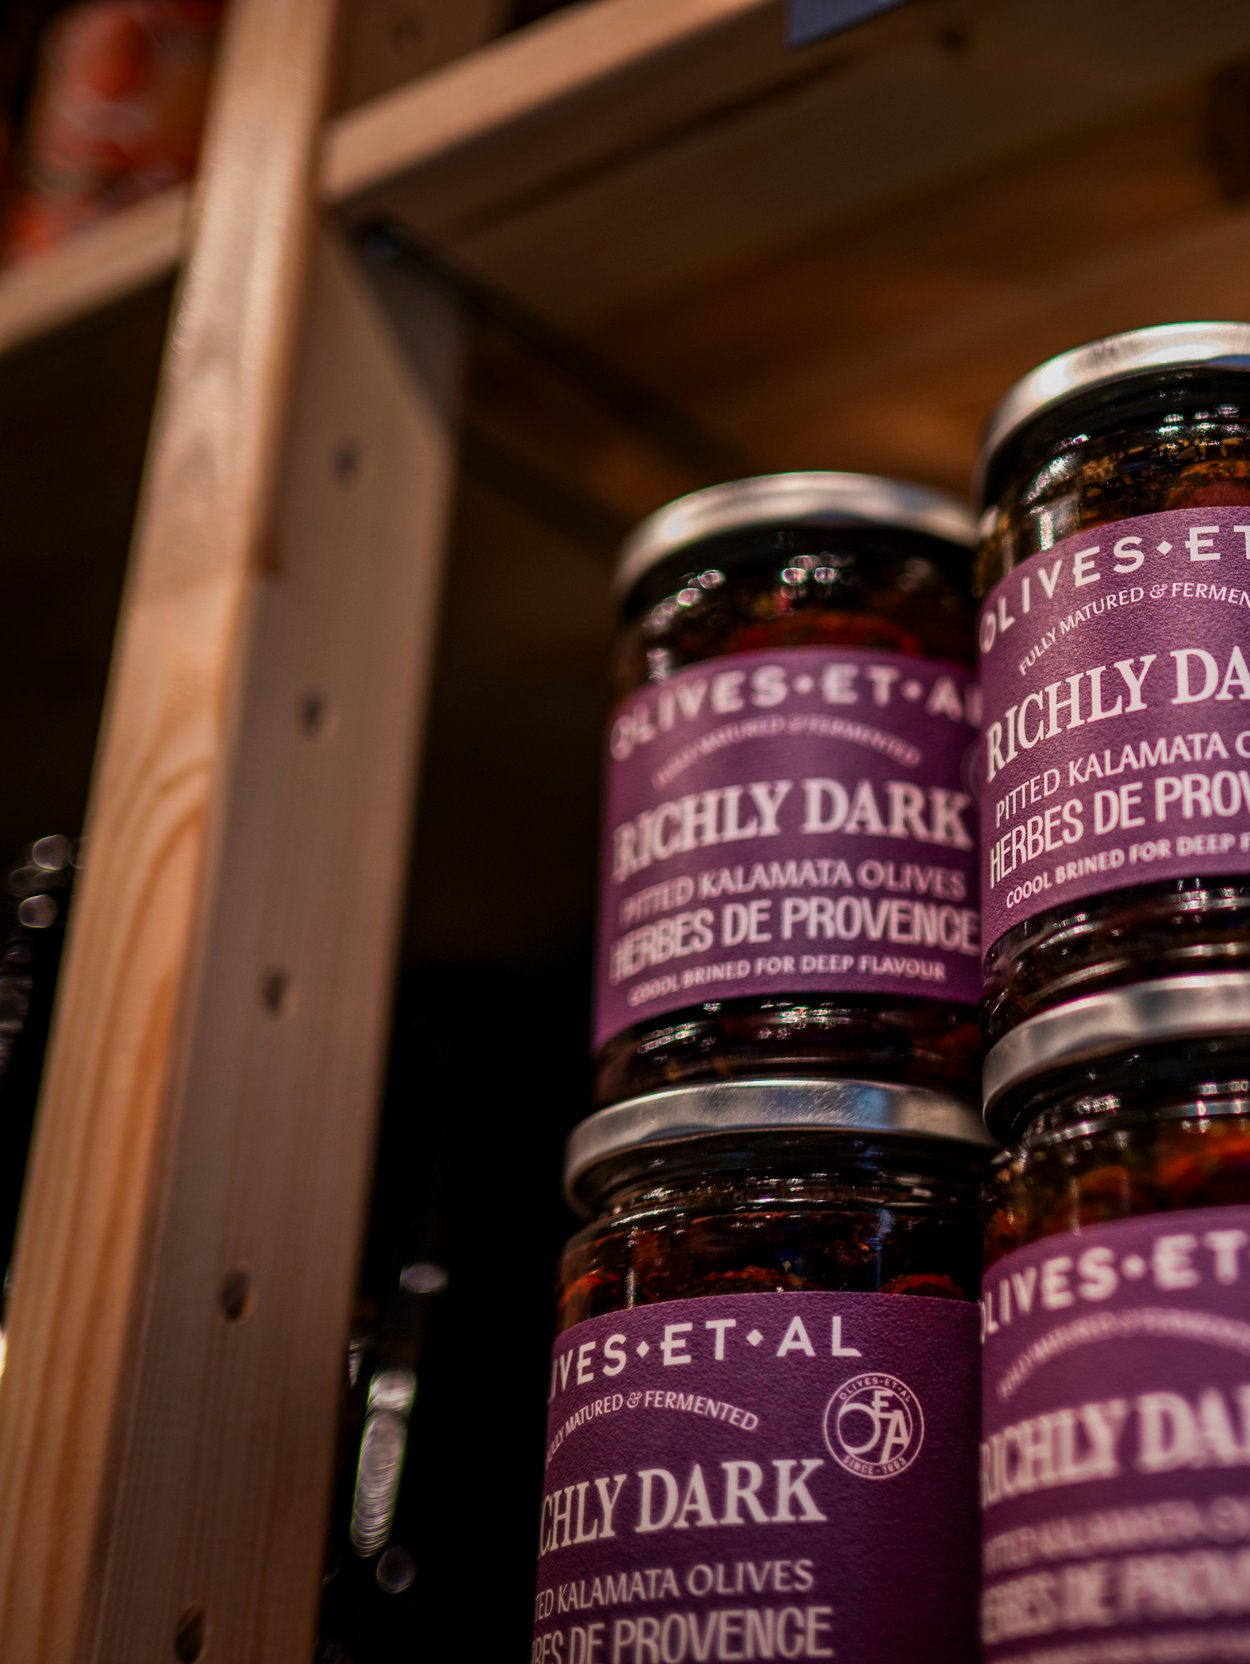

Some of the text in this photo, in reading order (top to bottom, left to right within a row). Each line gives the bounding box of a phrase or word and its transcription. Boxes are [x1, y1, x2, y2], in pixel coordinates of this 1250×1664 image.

[979, 536, 1145, 653] OLIVES
[1019, 628, 1057, 676] FULLY
[1059, 587, 1144, 635] MATURED
[1150, 583, 1168, 598] &
[610, 666, 788, 761] OLIVES
[822, 664, 899, 705] ET
[986, 654, 1156, 784] RICHLY
[995, 768, 1060, 829] PITTED
[1068, 731, 1229, 787] KALAMATA
[610, 777, 974, 886] RICHLY DARK
[990, 799, 1084, 889] HERBES
[1093, 781, 1145, 836] DE
[1006, 872, 1052, 909] COOOL
[1055, 849, 1125, 885] BRINED
[1128, 839, 1171, 865] FOR
[1176, 833, 1236, 857] DEEP
[699, 859, 853, 898] KALAMATA
[856, 860, 966, 900] OLIVES
[609, 896, 981, 986] HERBES DE PROVENCE
[681, 959, 750, 989] BRINED
[754, 956, 796, 976] FOR
[801, 955, 854, 975] DEEP
[856, 955, 948, 984] FLAVOUR
[1151, 1229, 1248, 1291] ET
[547, 1315, 863, 1405] IVES ET AL
[565, 1394, 623, 1437] MATURED
[627, 1391, 642, 1409] &
[645, 1390, 759, 1431] FERMENTED
[537, 1458, 827, 1558] CHLY DARK
[557, 1567, 680, 1614] KALAMATA
[687, 1559, 815, 1596] OLIVES
[614, 1606, 835, 1664] PROVENCE
